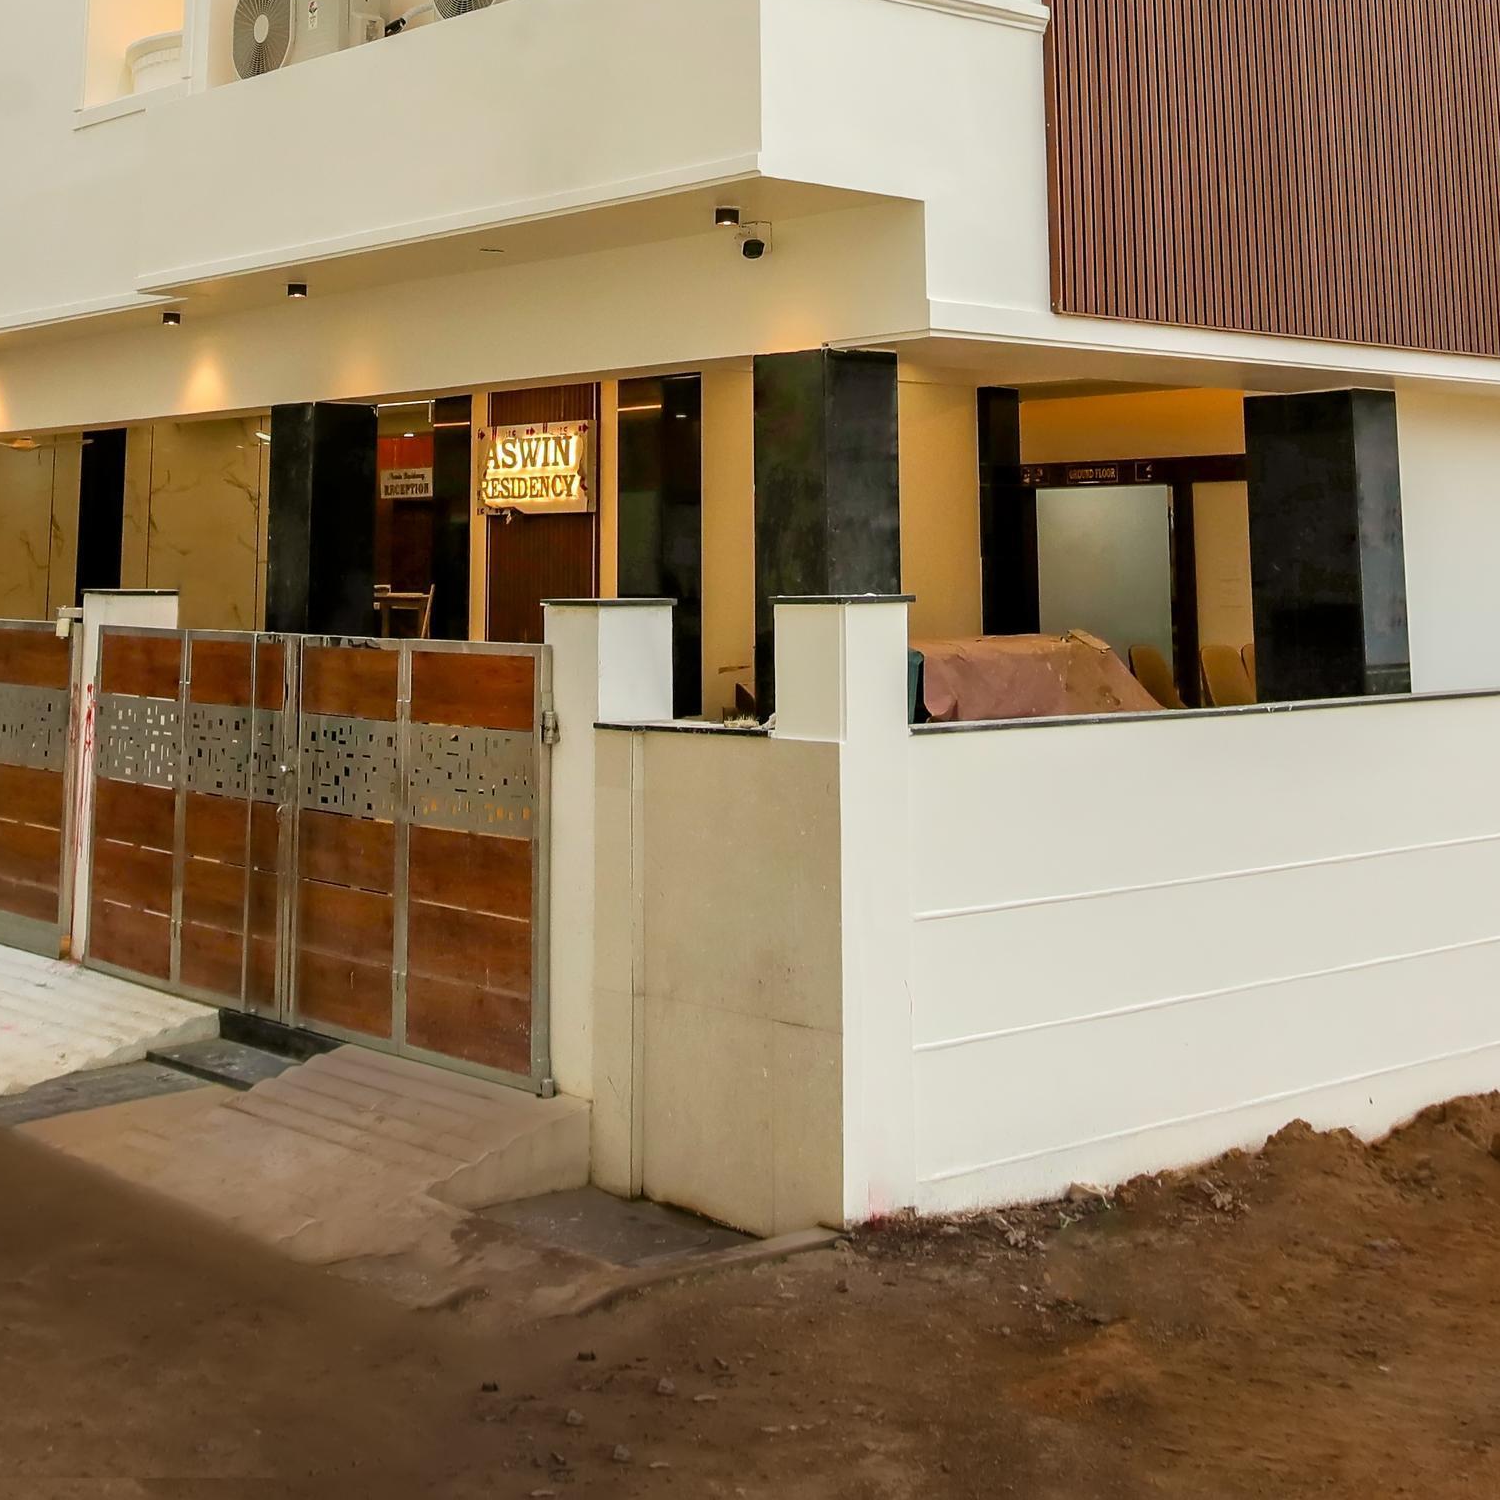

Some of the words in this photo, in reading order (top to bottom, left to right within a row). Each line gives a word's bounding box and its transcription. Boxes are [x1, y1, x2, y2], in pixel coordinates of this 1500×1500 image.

[485, 435, 573, 469] ASWIN
[1095, 467, 1116, 479] FLOOR
[384, 483, 429, 496] RECEPTION
[481, 474, 576, 499] RESIDENCY
